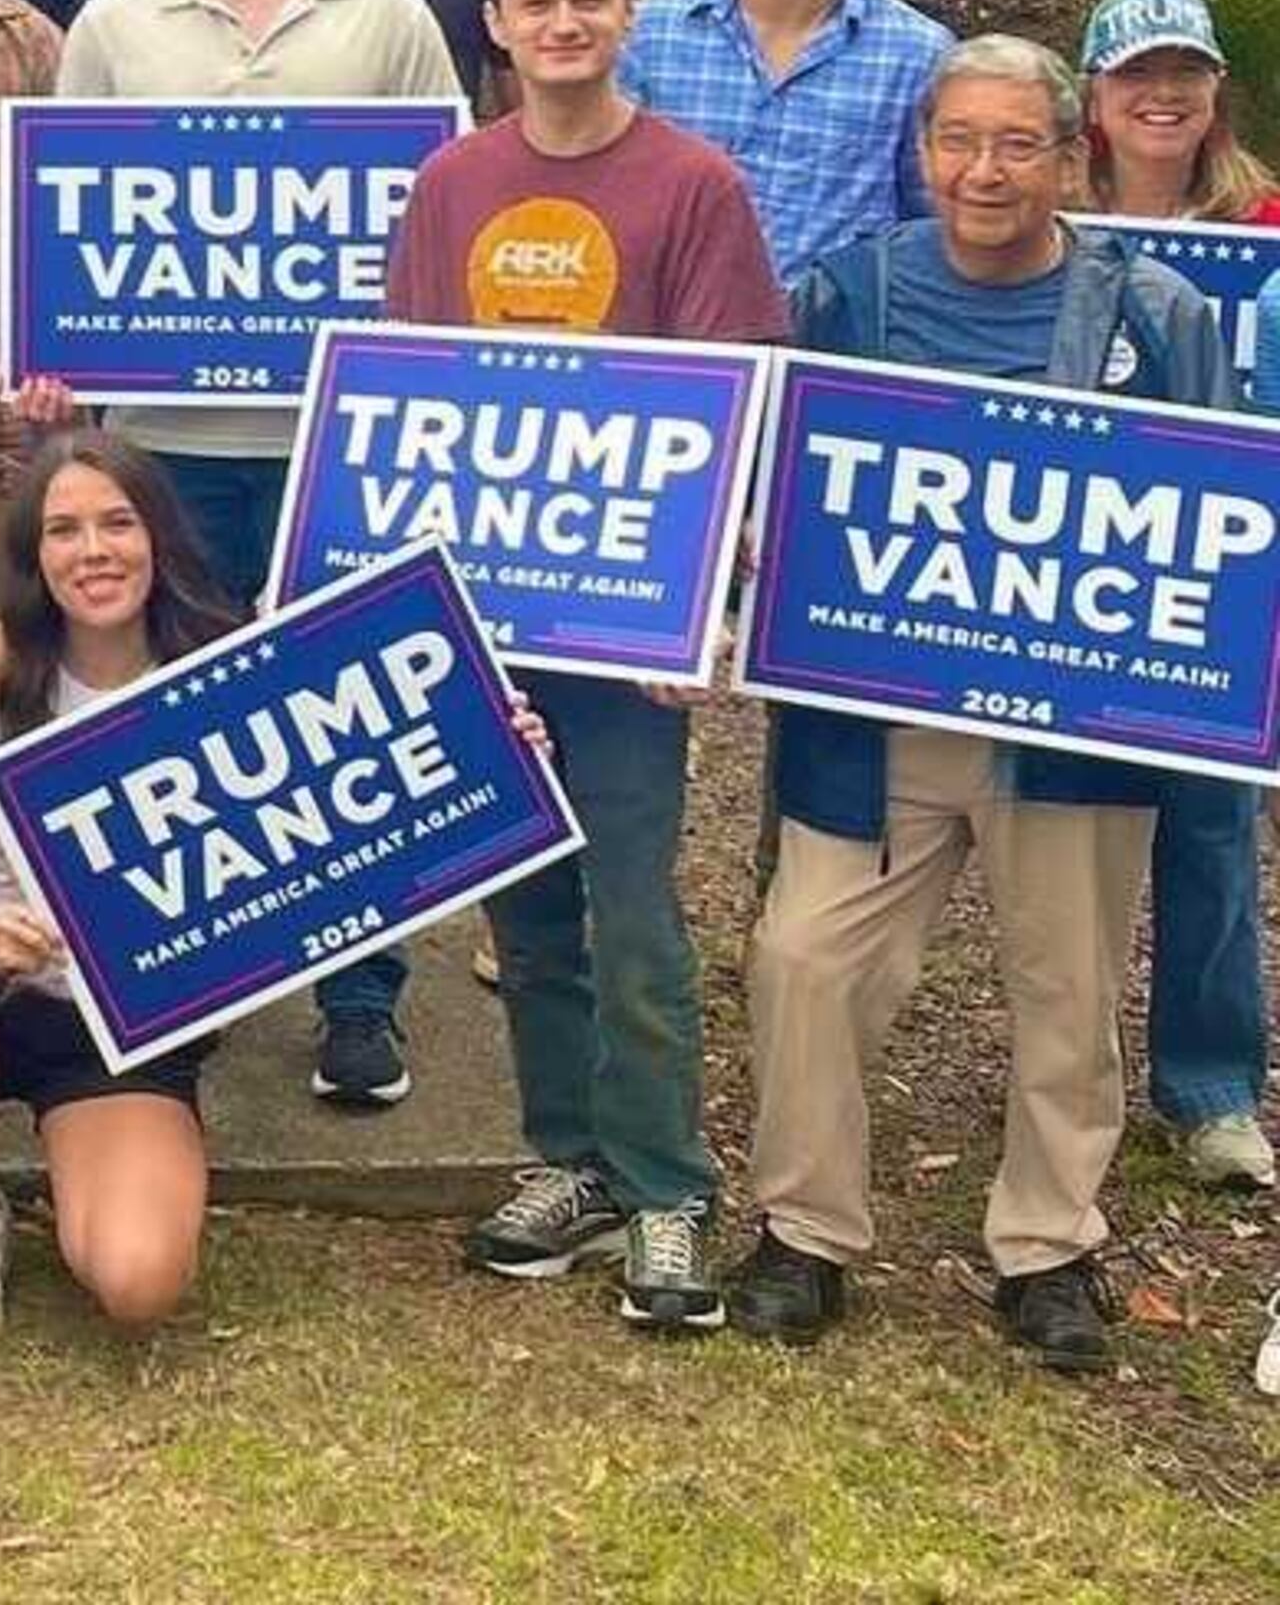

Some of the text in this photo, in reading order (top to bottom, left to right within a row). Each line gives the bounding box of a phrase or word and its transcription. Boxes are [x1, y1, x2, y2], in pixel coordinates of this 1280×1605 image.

[37, 165, 416, 236] TRUMP
[79, 242, 386, 301] VANCE
[56, 315, 123, 331] MAKE
[128, 315, 235, 333] AMERICA
[194, 367, 271, 387] 2024
[336, 394, 713, 492] TRUMP
[361, 475, 654, 562] VANCE
[808, 433, 1275, 573] TRUMP
[497, 566, 573, 592] GREAT
[846, 526, 1212, 649] VANCE
[808, 604, 1230, 689] MAKE AMERICA GREAT AGAIN!
[961, 688, 1053, 725] 2024
[43, 630, 455, 874] TRUMP
[122, 722, 458, 922] VANCE
[133, 786, 496, 973] MAKE AMERICA GREAT AGAIN!
[301, 906, 384, 961] 2024
